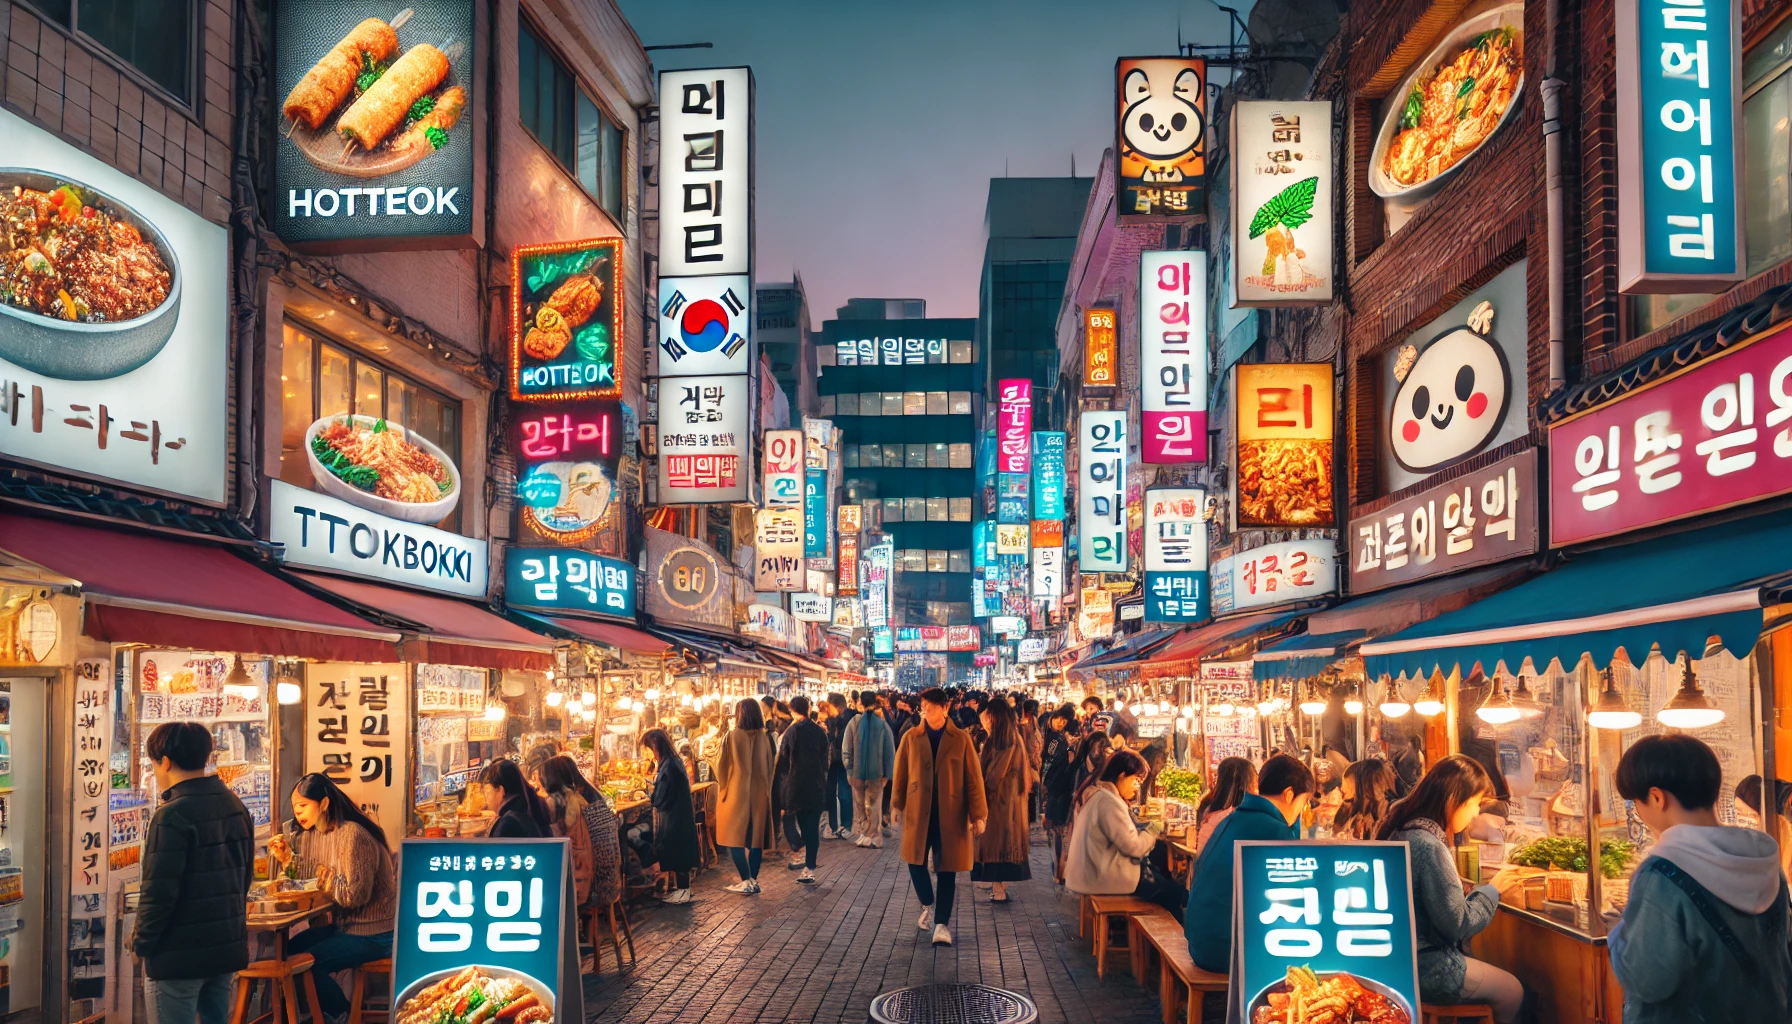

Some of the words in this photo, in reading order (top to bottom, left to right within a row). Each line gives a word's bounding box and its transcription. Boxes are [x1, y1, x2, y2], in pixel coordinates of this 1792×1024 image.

[288, 186, 460, 218] HOTTEOK
[523, 363, 615, 387] HOTTEOK
[293, 506, 473, 583] TTOKBOKKI
